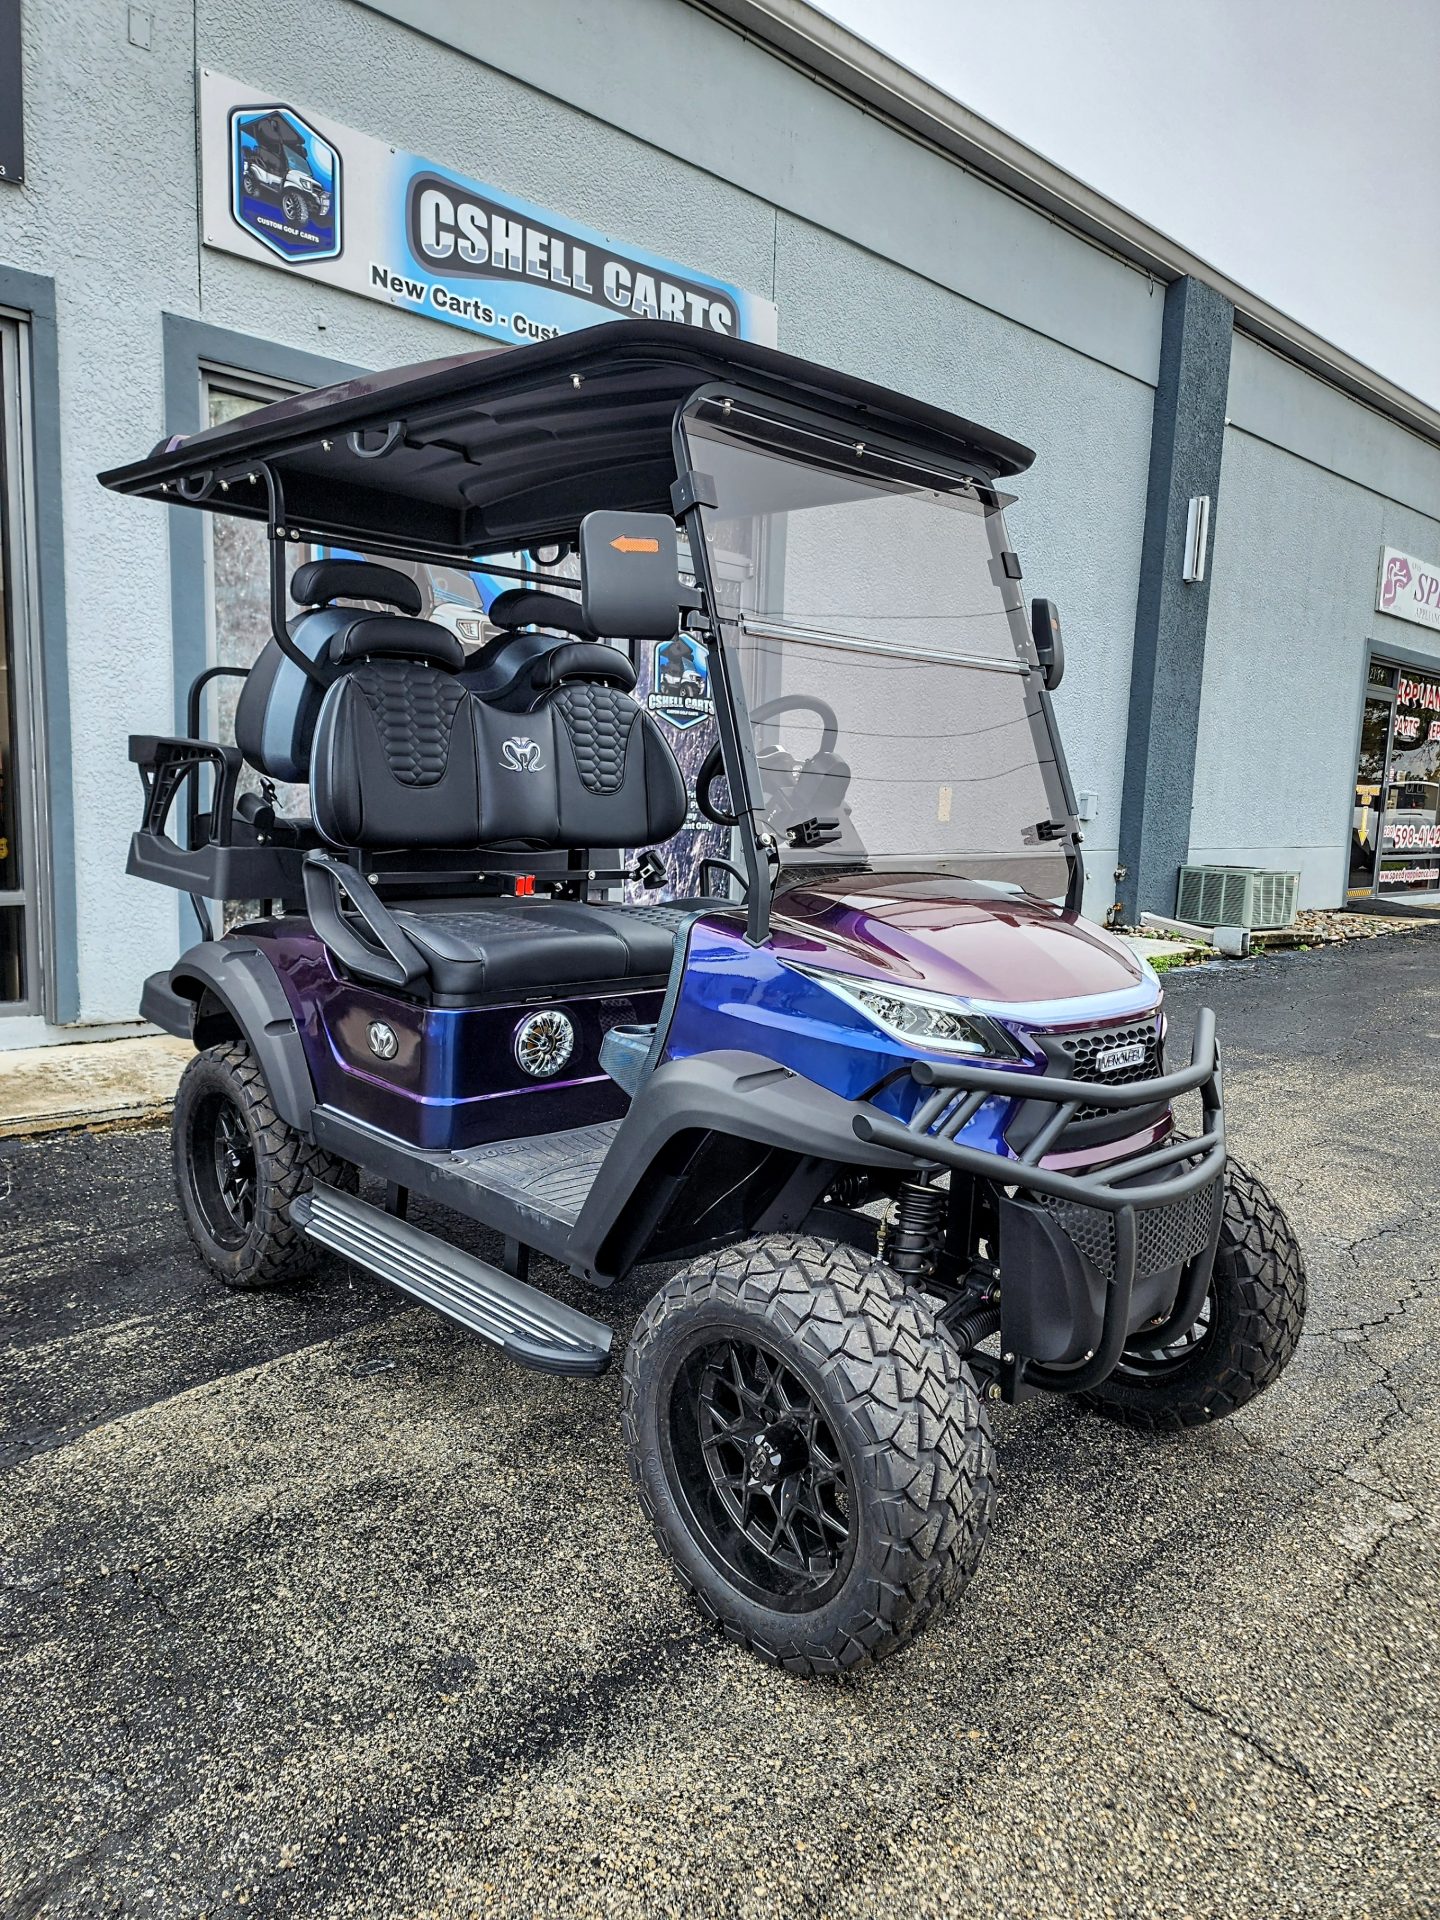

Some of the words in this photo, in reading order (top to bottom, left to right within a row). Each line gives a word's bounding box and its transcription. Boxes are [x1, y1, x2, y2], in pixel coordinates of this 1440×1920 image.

[257, 217, 283, 230] CUSTOM
[283, 226, 299, 235] GOLF
[300, 231, 320, 242] CARTS
[420, 189, 593, 294] CSHELL
[603, 261, 732, 335] CARTS
[371, 265, 425, 300] New
[432, 288, 493, 323] Carts
[1413, 573, 1440, 609] SP
[649, 694, 684, 709] CSHELL
[685, 698, 715, 714] CARTS
[1394, 714, 1420, 738] PARTS
[696, 822, 713, 831] Only
